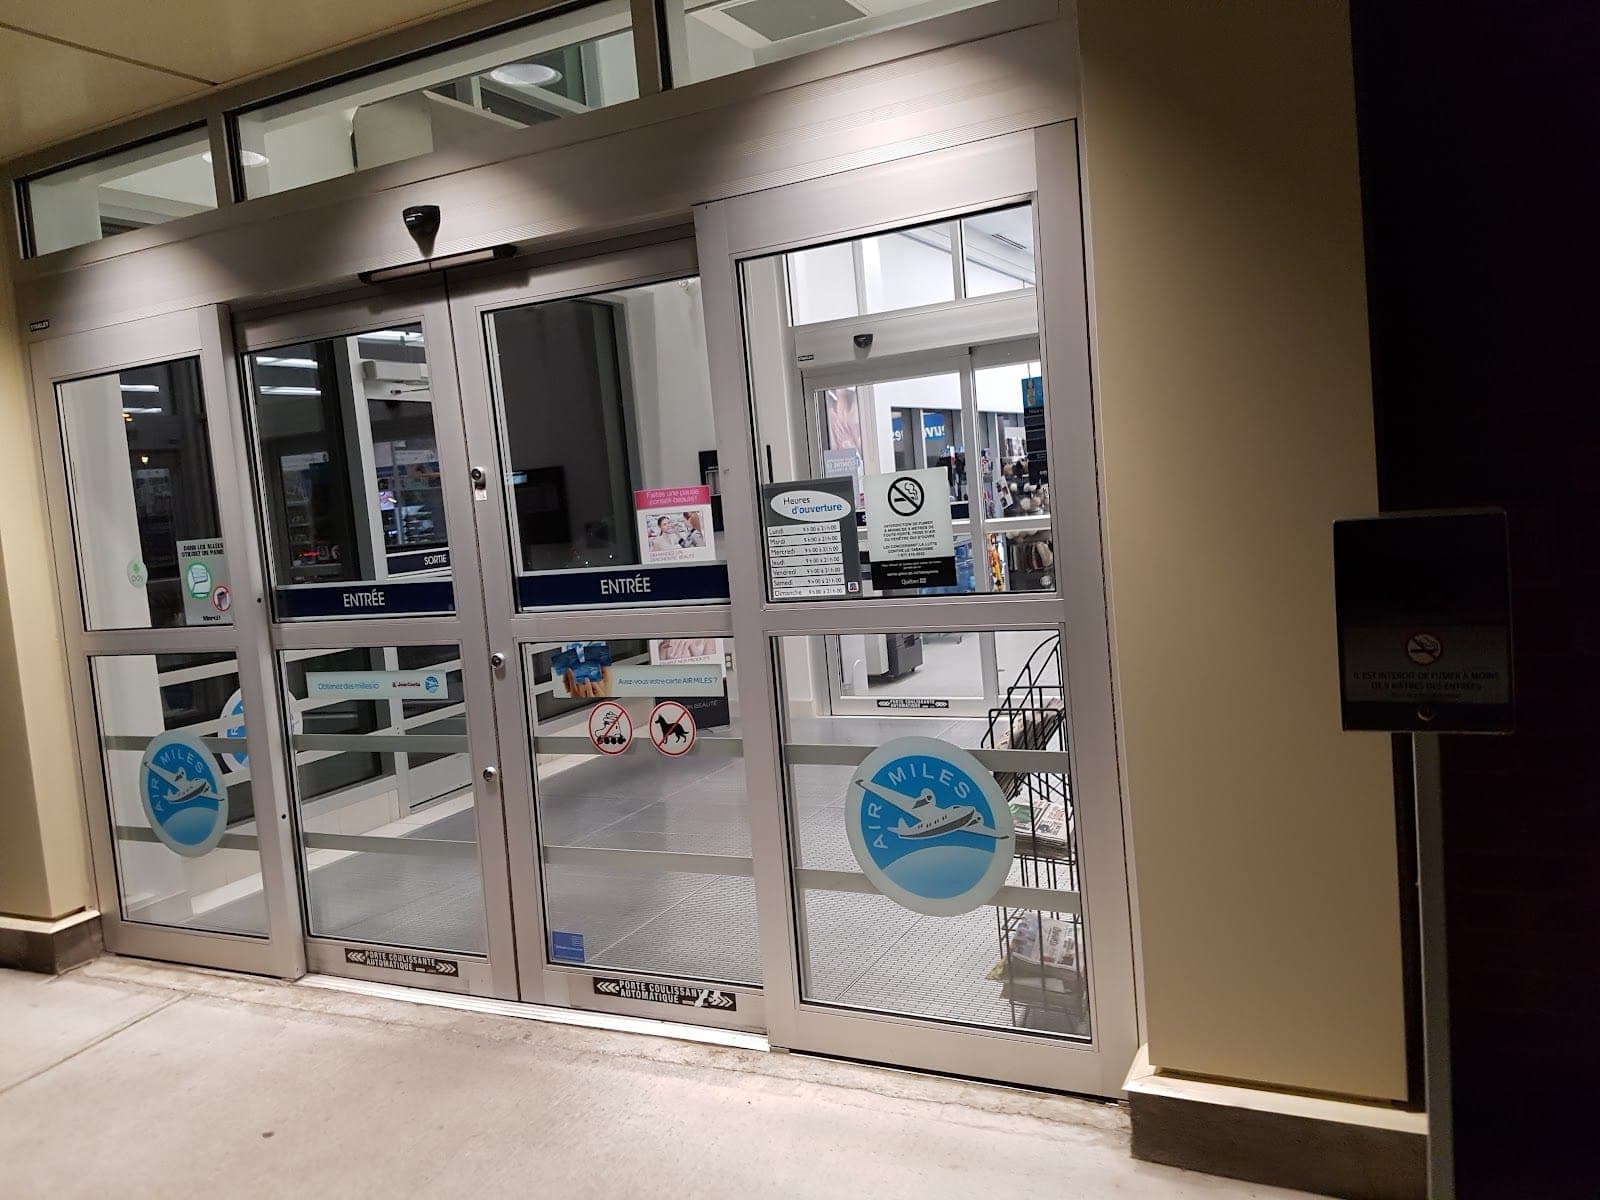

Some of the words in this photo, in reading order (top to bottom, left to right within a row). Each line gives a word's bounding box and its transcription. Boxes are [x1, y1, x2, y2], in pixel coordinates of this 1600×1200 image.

[784, 497, 810, 505] Heures
[792, 502, 842, 515] d'ouverture
[771, 548, 796, 556] Mercredi
[424, 554, 448, 565] SORTIE
[773, 568, 797, 576] Vendredi
[601, 574, 652, 595] ENTRÉE
[343, 588, 386, 608] ENTRÉE
[151, 777, 166, 812] AIR
[160, 749, 204, 775] MILES
[868, 802, 888, 850] AIR
[887, 762, 971, 799] MILES
[365, 950, 387, 960] PORTE
[388, 953, 436, 966] COULISSANTE
[366, 957, 414, 971] AUTOMATIQUE
[619, 980, 647, 991] PORTE
[620, 988, 680, 1004] AUTOMATIQUE
